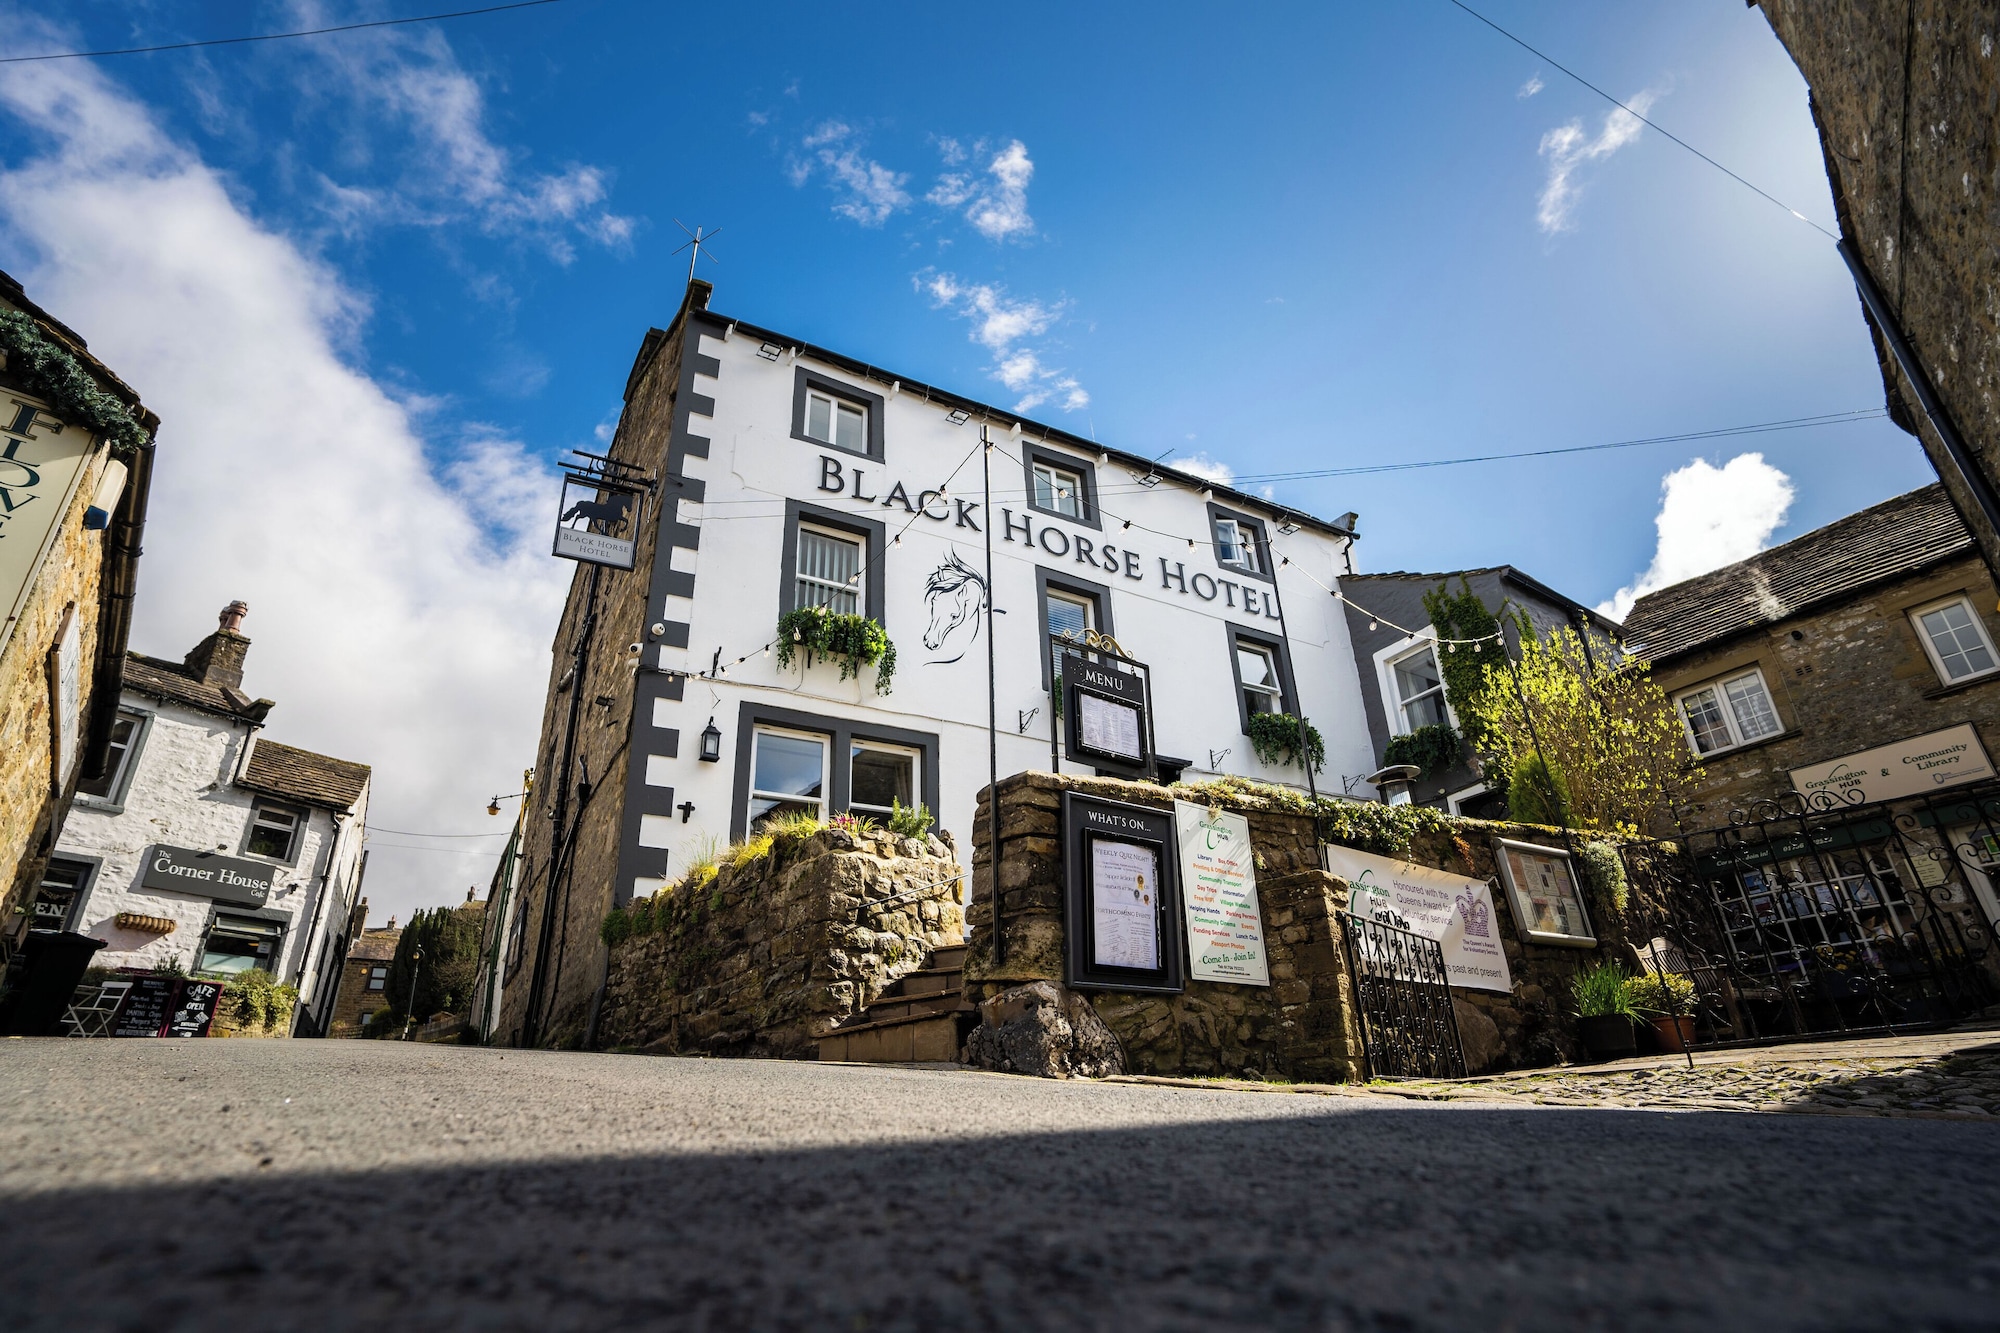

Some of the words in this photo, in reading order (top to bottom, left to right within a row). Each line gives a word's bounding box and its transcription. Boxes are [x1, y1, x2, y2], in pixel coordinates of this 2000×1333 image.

[563, 533, 594, 546] BLACK
[597, 540, 629, 553] HORSE
[818, 454, 982, 532] BLACK
[1001, 508, 1144, 581] HORSE
[1158, 556, 1281, 620] HOTEL
[580, 546, 611, 558] HOTEL
[1085, 669, 1123, 691] MENU
[1902, 744, 1967, 764] Community
[1916, 755, 1960, 771] Library
[1805, 770, 1868, 789] Grassington
[1880, 768, 1891, 776] &
[1838, 779, 1862, 789] HUB
[1088, 810, 1126, 828] WHAT'S
[1199, 820, 1232, 834] Grassington
[1216, 833, 1229, 841] HUB
[158, 850, 172, 858] The
[1118, 851, 1132, 860] QUIZ
[1197, 854, 1212, 862] Library
[154, 858, 214, 881] Corner
[217, 868, 268, 890] House
[1192, 863, 1210, 872] Printing
[1228, 870, 1244, 878] Services
[1198, 874, 1222, 884] Community
[1222, 879, 1242, 887] Transport
[1206, 886, 1217, 894] Trips
[1222, 890, 1246, 898] Information
[1346, 880, 1391, 898] assington
[1393, 880, 1424, 895] Honoured
[1426, 888, 1438, 898] with
[1438, 890, 1449, 900] the
[1194, 894, 1204, 902] Free
[1220, 899, 1234, 907] Village
[1370, 896, 1388, 908] HUB
[1396, 894, 1422, 907] Queens
[1422, 900, 1442, 910] Award
[1442, 902, 1452, 913] for
[33, 902, 66, 918] EN
[1189, 904, 1206, 913] Helping
[1226, 910, 1242, 918] Parking
[1242, 912, 1258, 920] Permits
[1398, 906, 1430, 923] Voluntary
[1430, 914, 1454, 926] service
[1194, 916, 1219, 926] Community
[1220, 920, 1236, 928] Cinema
[1194, 927, 1211, 936] Funding
[1212, 930, 1230, 938] Services
[1210, 940, 1230, 948] Passport
[1231, 942, 1246, 950] Photos
[1486, 948, 1498, 956] Service
[1202, 955, 1222, 964] Come
[1222, 954, 1230, 962] In
[1234, 952, 1247, 962] Join
[1248, 951, 1256, 960] In!
[1452, 964, 1466, 973] past
[1467, 966, 1480, 975] and
[1480, 968, 1503, 979] present
[186, 1002, 206, 1010] OPEN
